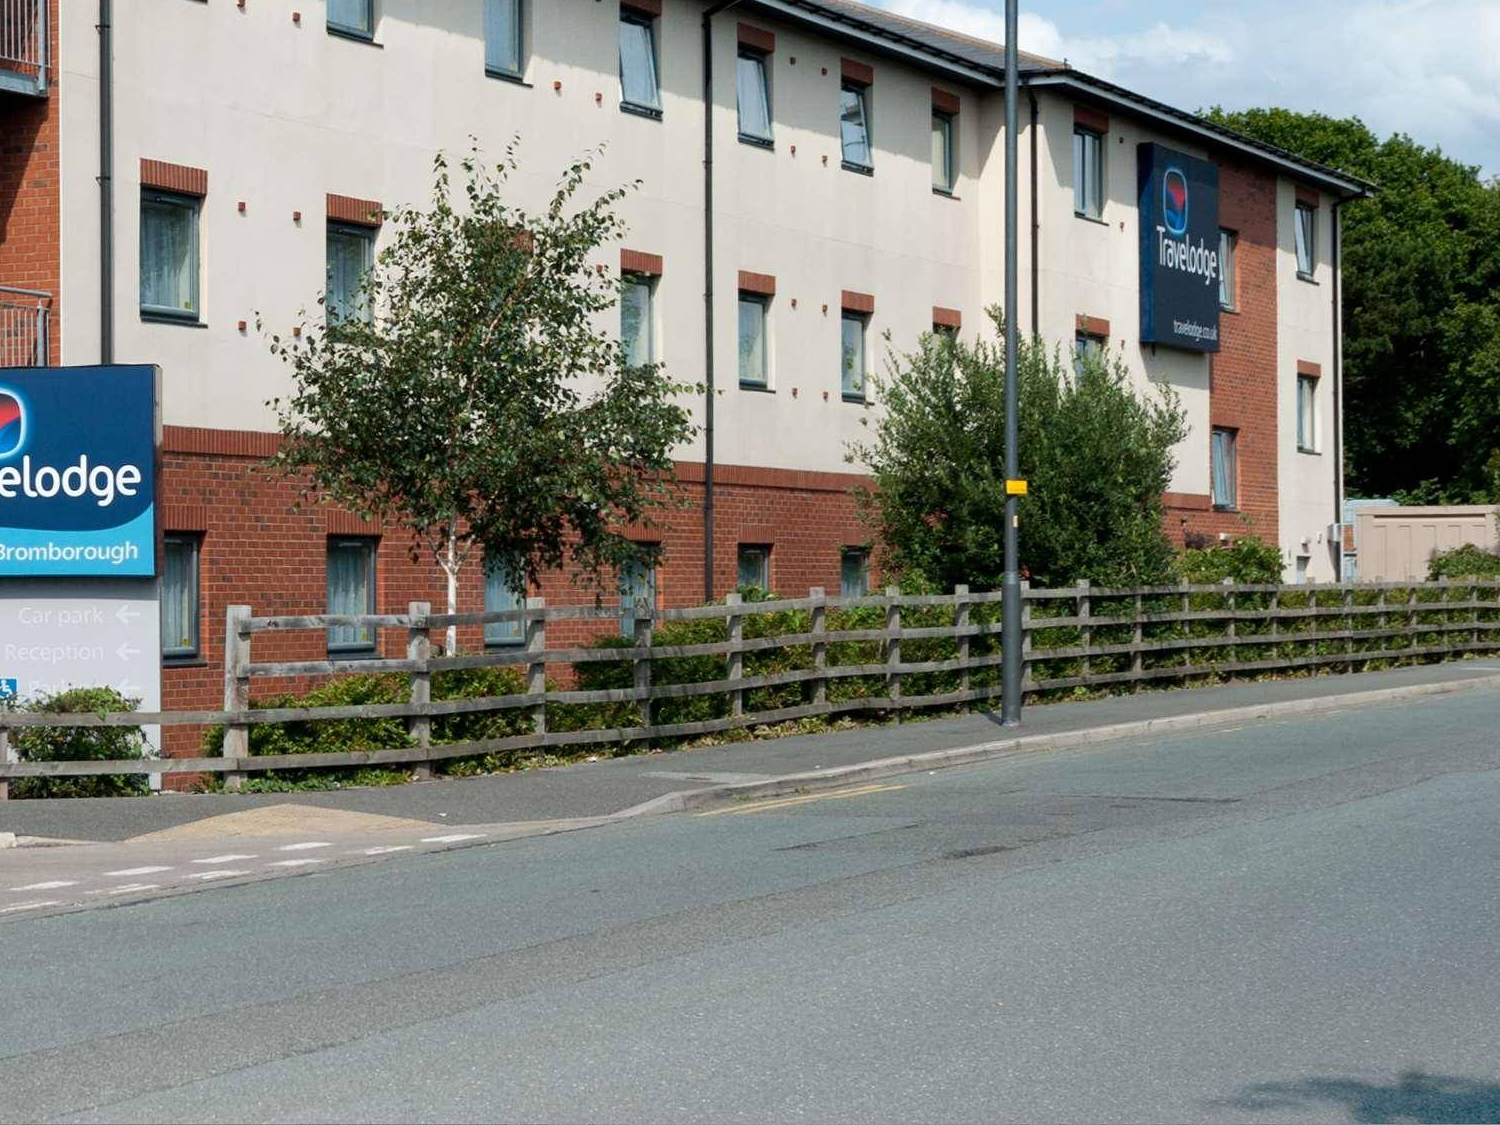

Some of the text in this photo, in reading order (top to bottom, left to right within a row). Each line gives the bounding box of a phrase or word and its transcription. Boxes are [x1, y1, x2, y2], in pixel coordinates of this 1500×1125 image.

[1156, 225, 1217, 286] Travelodge
[18, 606, 104, 628] Car park
[4, 643, 105, 665] Reception
